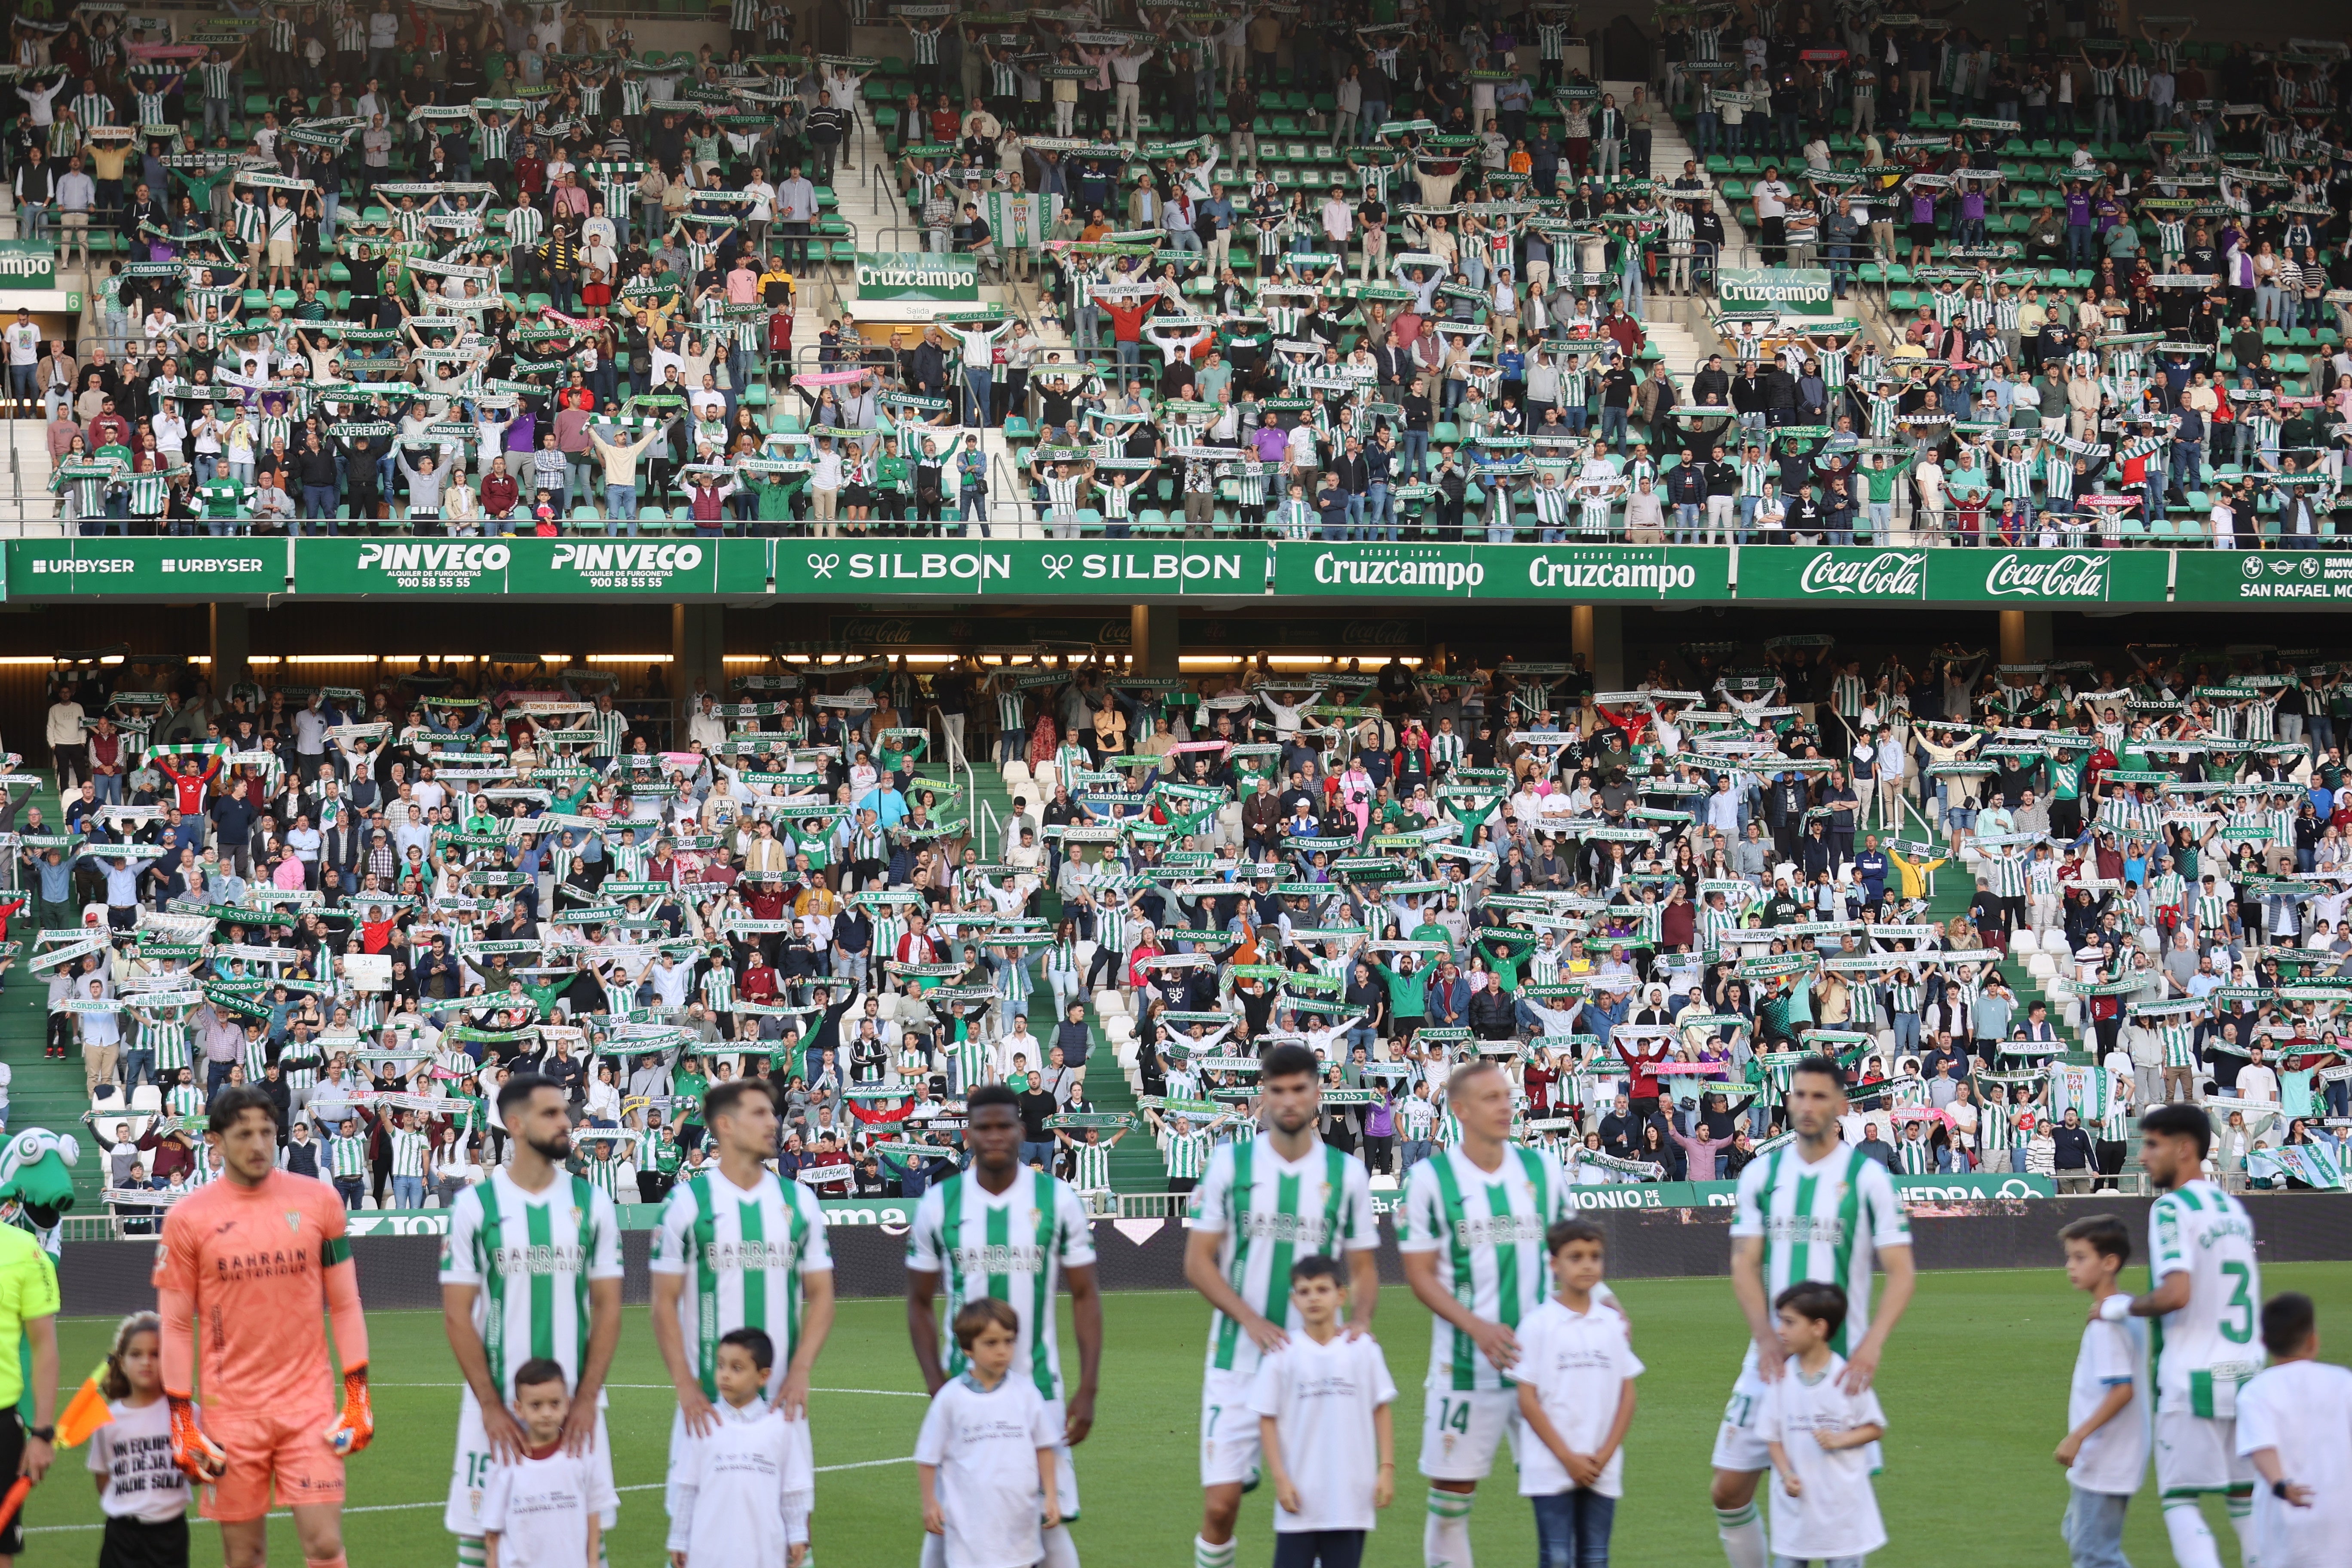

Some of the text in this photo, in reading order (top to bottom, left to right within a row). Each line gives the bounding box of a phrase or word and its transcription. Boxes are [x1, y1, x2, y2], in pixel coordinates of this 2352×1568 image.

[291, 129, 327, 143] CÓRDOBA
[253, 175, 285, 185] CÓRDOBA
[0, 258, 51, 278] mpo
[858, 264, 974, 290] Cruzcampo
[1721, 282, 1829, 304] Cruzcampo
[69, 295, 79, 309] 6
[891, 394, 929, 405] CÓRDOBA
[328, 426, 392, 436] OLVEREMOS
[912, 422, 929, 430] SOMOS
[358, 544, 511, 570] PINVECO
[551, 544, 702, 570] PINVECO
[49, 559, 135, 573] URBYSER
[179, 559, 262, 572] URBYSER
[849, 554, 1011, 579] SILBON
[1082, 554, 1241, 579] SILBON
[1314, 551, 1484, 591] Cruzcampo
[1529, 554, 1695, 593] Cruzcampo
[1801, 552, 1928, 594] Coca-Cola
[1986, 554, 2111, 596] Coca-Cola
[398, 578, 470, 587] 900 58 55 55
[591, 578, 662, 587] 900 58 55 55
[2240, 584, 2271, 597] SAN
[2274, 584, 2331, 597] RAFAEL
[2202, 688, 2244, 696] CÓRDOBA
[1458, 767, 1495, 775] CÓRDOBA
[748, 774, 794, 783] CÓRDOBA
[714, 800, 735, 808] BLINK
[1482, 928, 1523, 940] CÓRDOBA
[144, 946, 186, 955] CÓRDOBA
[1660, 955, 1704, 964] CÓRDOBA
[1528, 986, 1569, 995] CÓRDOBA
[2009, 1069, 2035, 1078] VOLVIENDO
[1643, 1190, 1657, 1198] DE
[1645, 1199, 1661, 1207] LA
[494, 1245, 586, 1264] BAHRAIN
[705, 1240, 797, 1256] BAHRAIN
[952, 1244, 1045, 1263] BAHRAIN
[217, 1248, 307, 1271] BAHRAIN
[2220, 1261, 2253, 1344] 3
[1208, 1403, 1222, 1437] 7
[1439, 1398, 1469, 1435] 14
